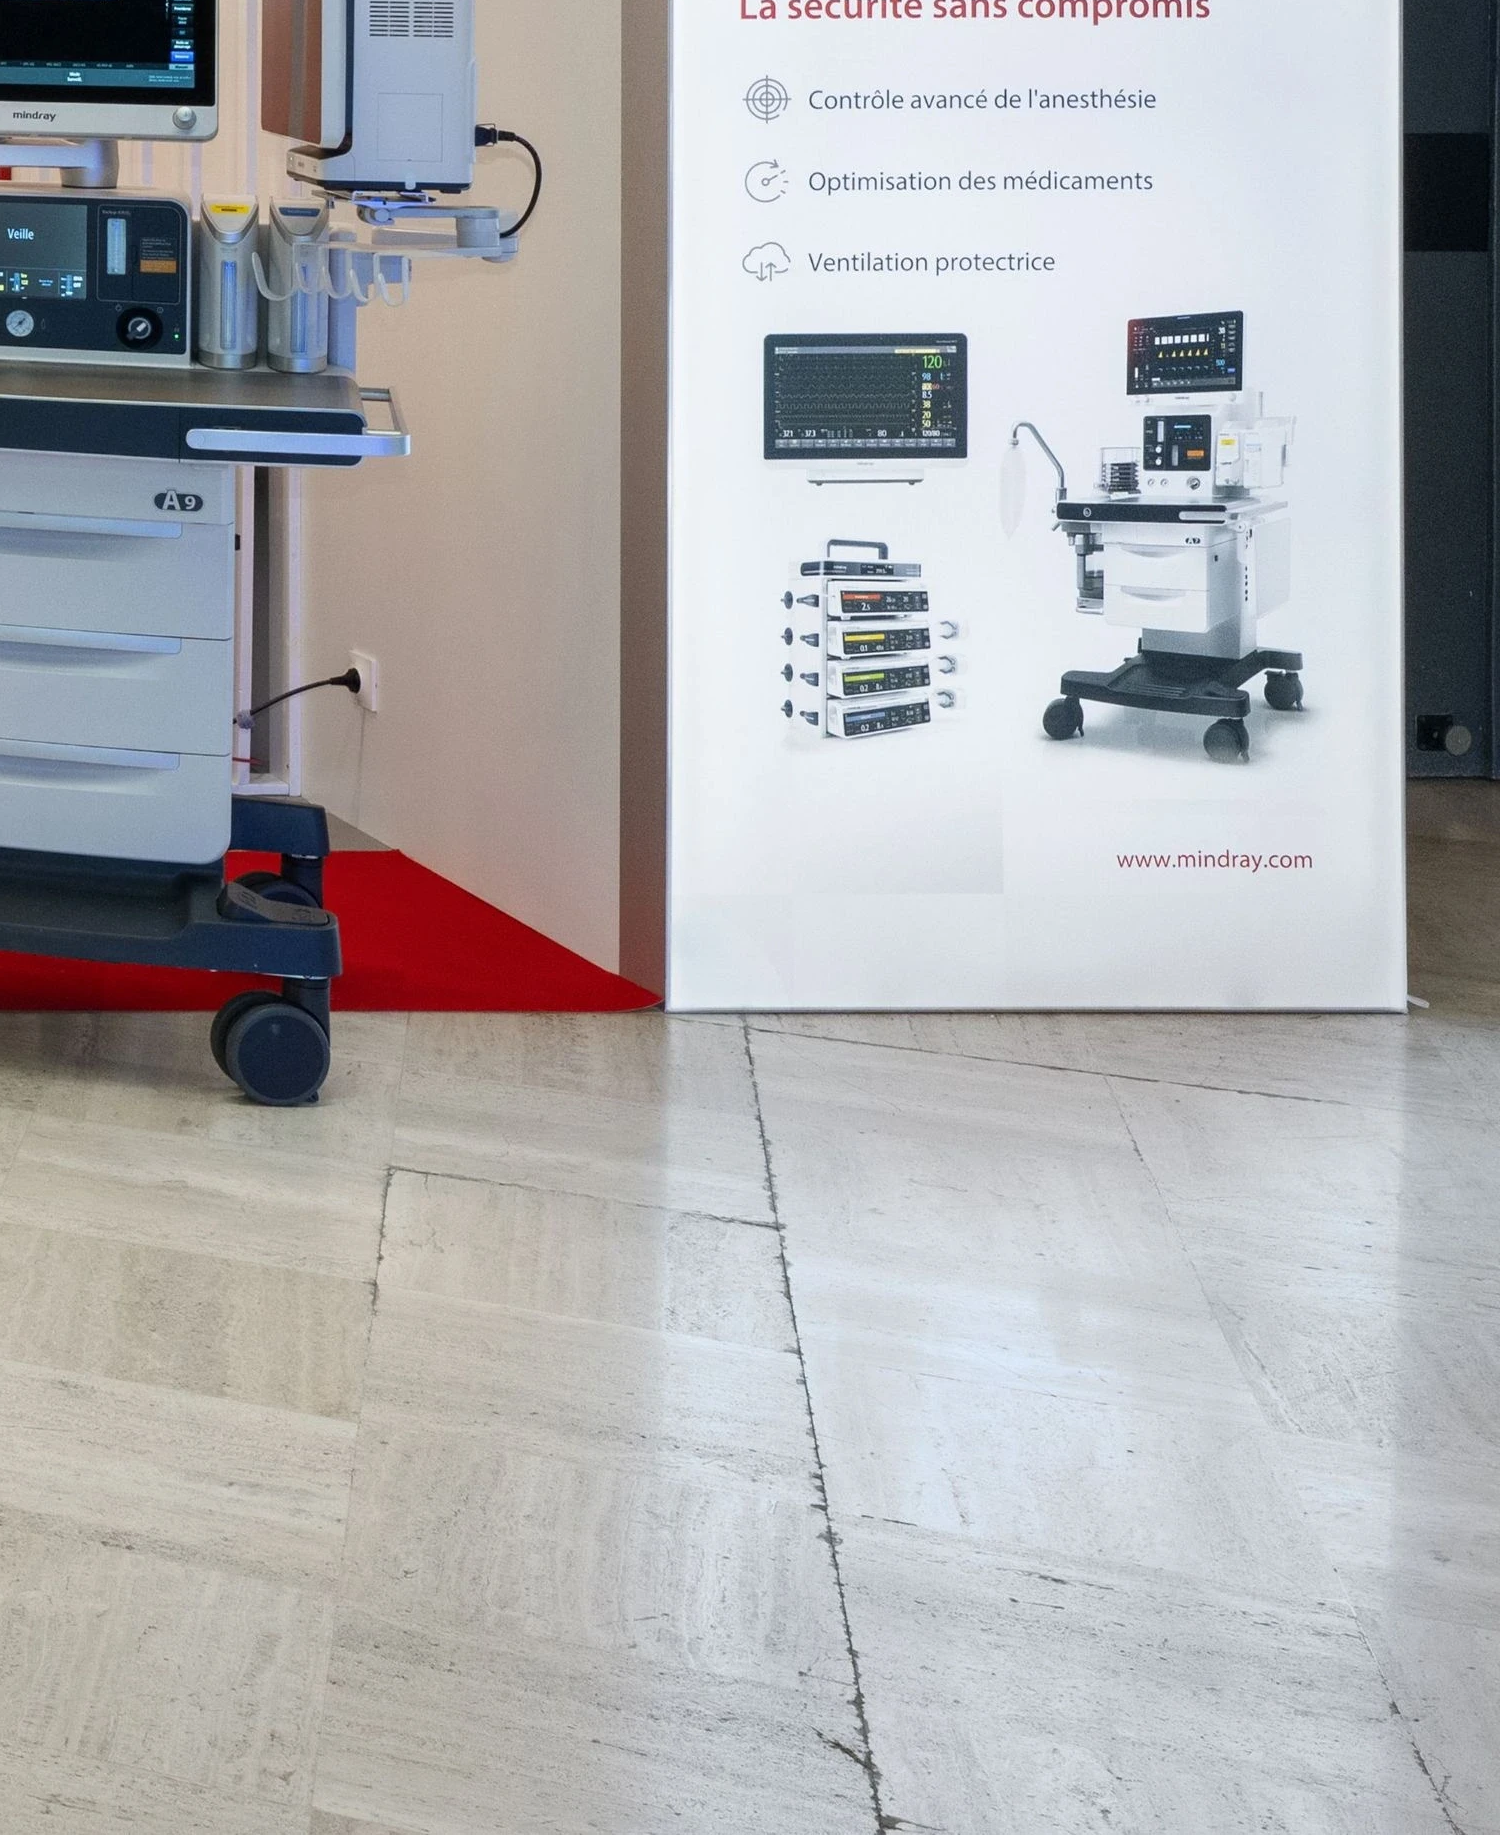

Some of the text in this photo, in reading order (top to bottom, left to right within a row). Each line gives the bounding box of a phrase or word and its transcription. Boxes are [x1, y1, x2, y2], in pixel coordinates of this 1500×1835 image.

[809, 89, 1156, 109] Contrôle avancé de l'anesthésie
[13, 111, 56, 122] mindray
[809, 170, 1152, 195] Optimisation des médicaments
[8, 229, 34, 240] Veille
[809, 252, 1055, 276] Ventilation protectrice
[922, 356, 943, 369] 120
[162, 488, 196, 512] A9
[1117, 849, 1312, 873] www.mindray.com
